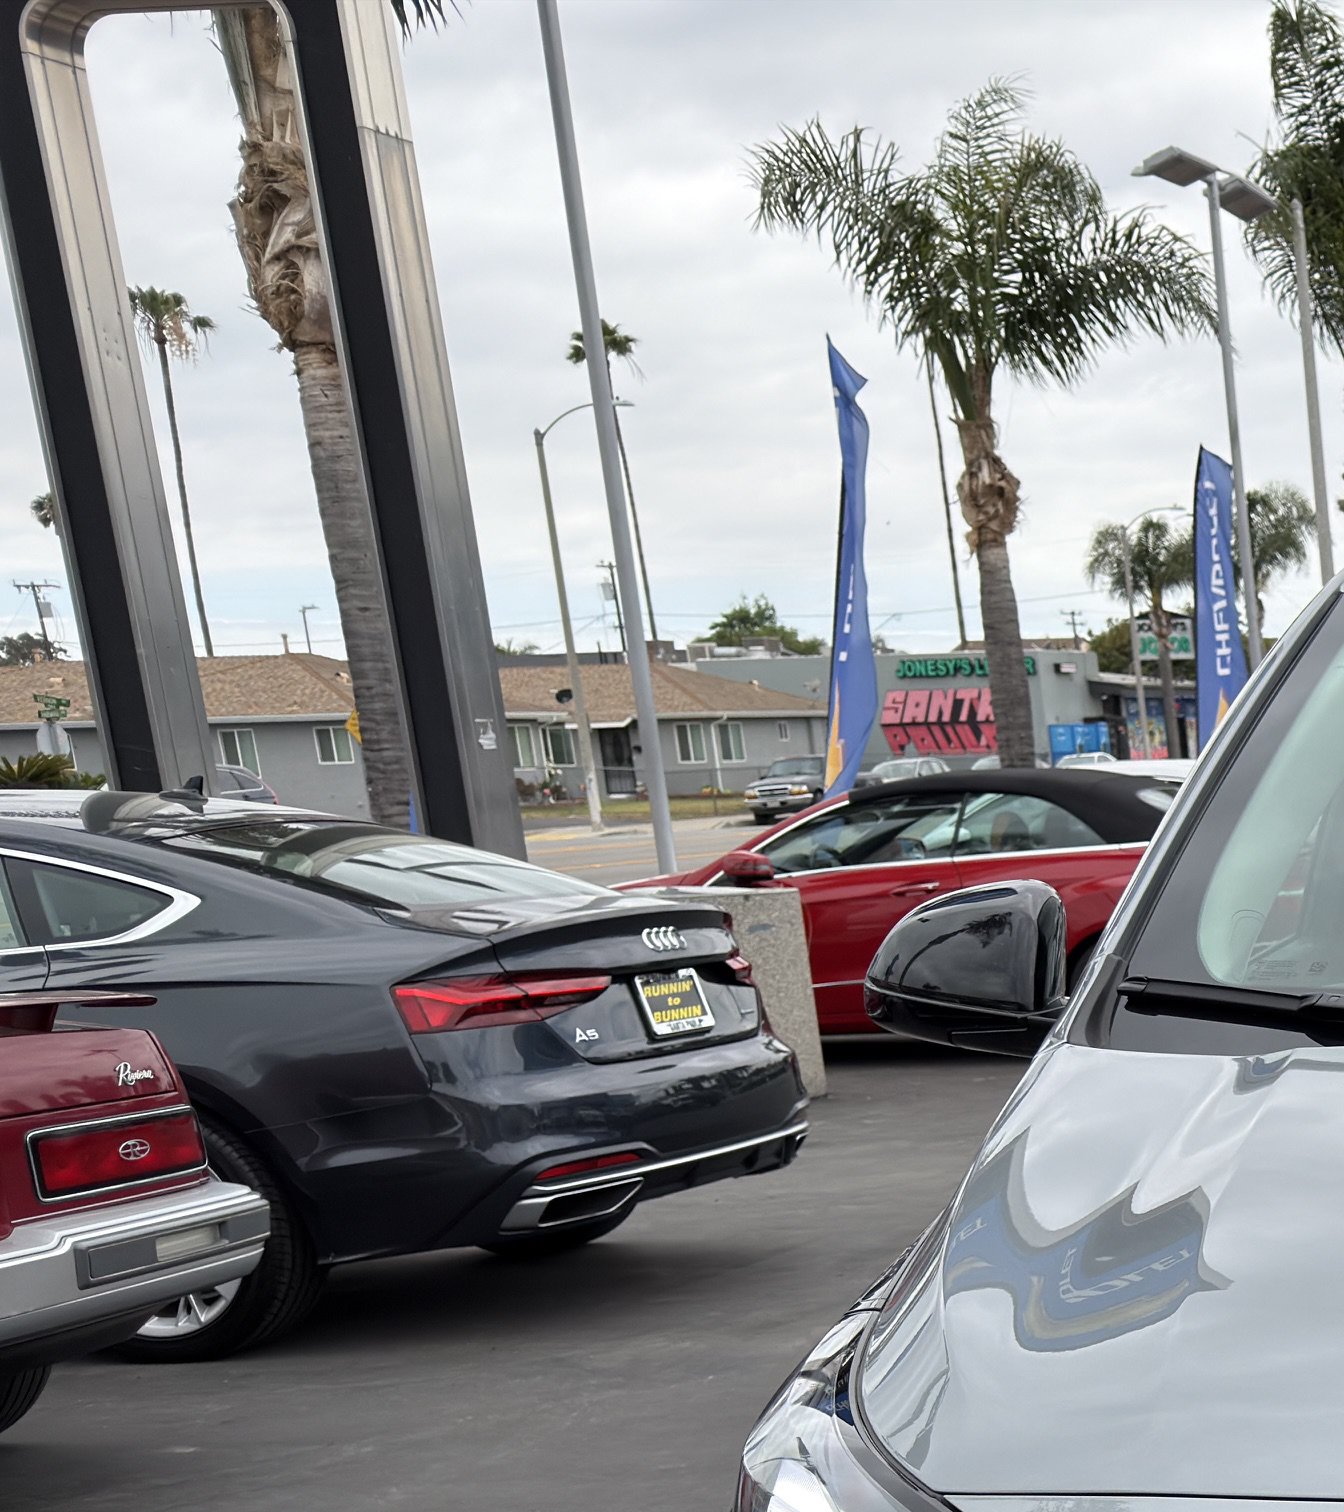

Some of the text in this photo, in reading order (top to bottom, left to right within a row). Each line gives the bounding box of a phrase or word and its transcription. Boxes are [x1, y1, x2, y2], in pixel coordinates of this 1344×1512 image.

[895, 656, 1035, 677] JONESY'S LIR
[643, 980, 694, 997] RUNNIN'
[667, 996, 681, 1006] to
[653, 1005, 702, 1023] BUNNIN
[575, 1028, 599, 1043] A5
